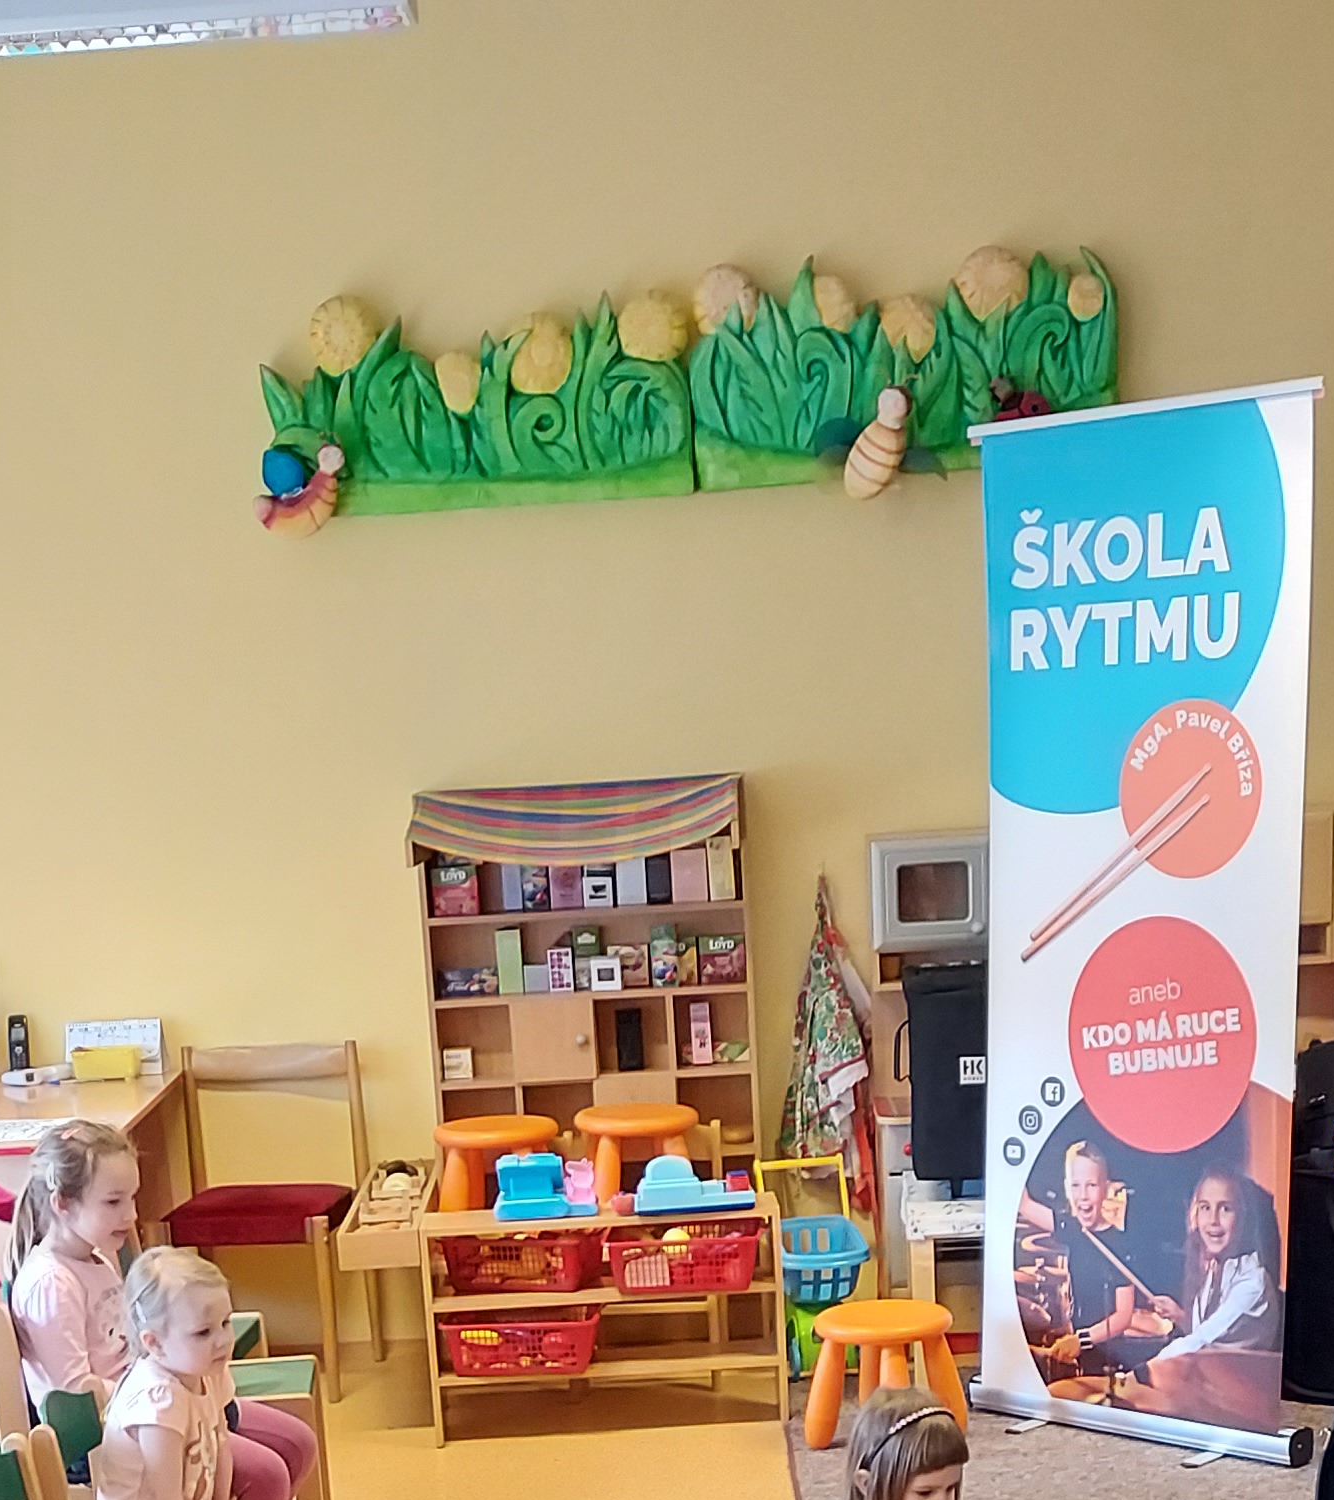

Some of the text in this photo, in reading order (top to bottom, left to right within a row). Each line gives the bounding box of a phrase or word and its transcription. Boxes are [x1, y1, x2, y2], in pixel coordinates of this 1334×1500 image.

[1010, 506, 1231, 589] ŠKOLA
[1010, 591, 1241, 671] RYTMU
[1130, 709, 1254, 797] MgA. Pavel Bříza
[708, 938, 735, 950] LOYD
[1129, 977, 1181, 1005] aneb
[1082, 1007, 1241, 1050] KDO MÁ RUCE
[1107, 1040, 1219, 1077] BUBNUJE
